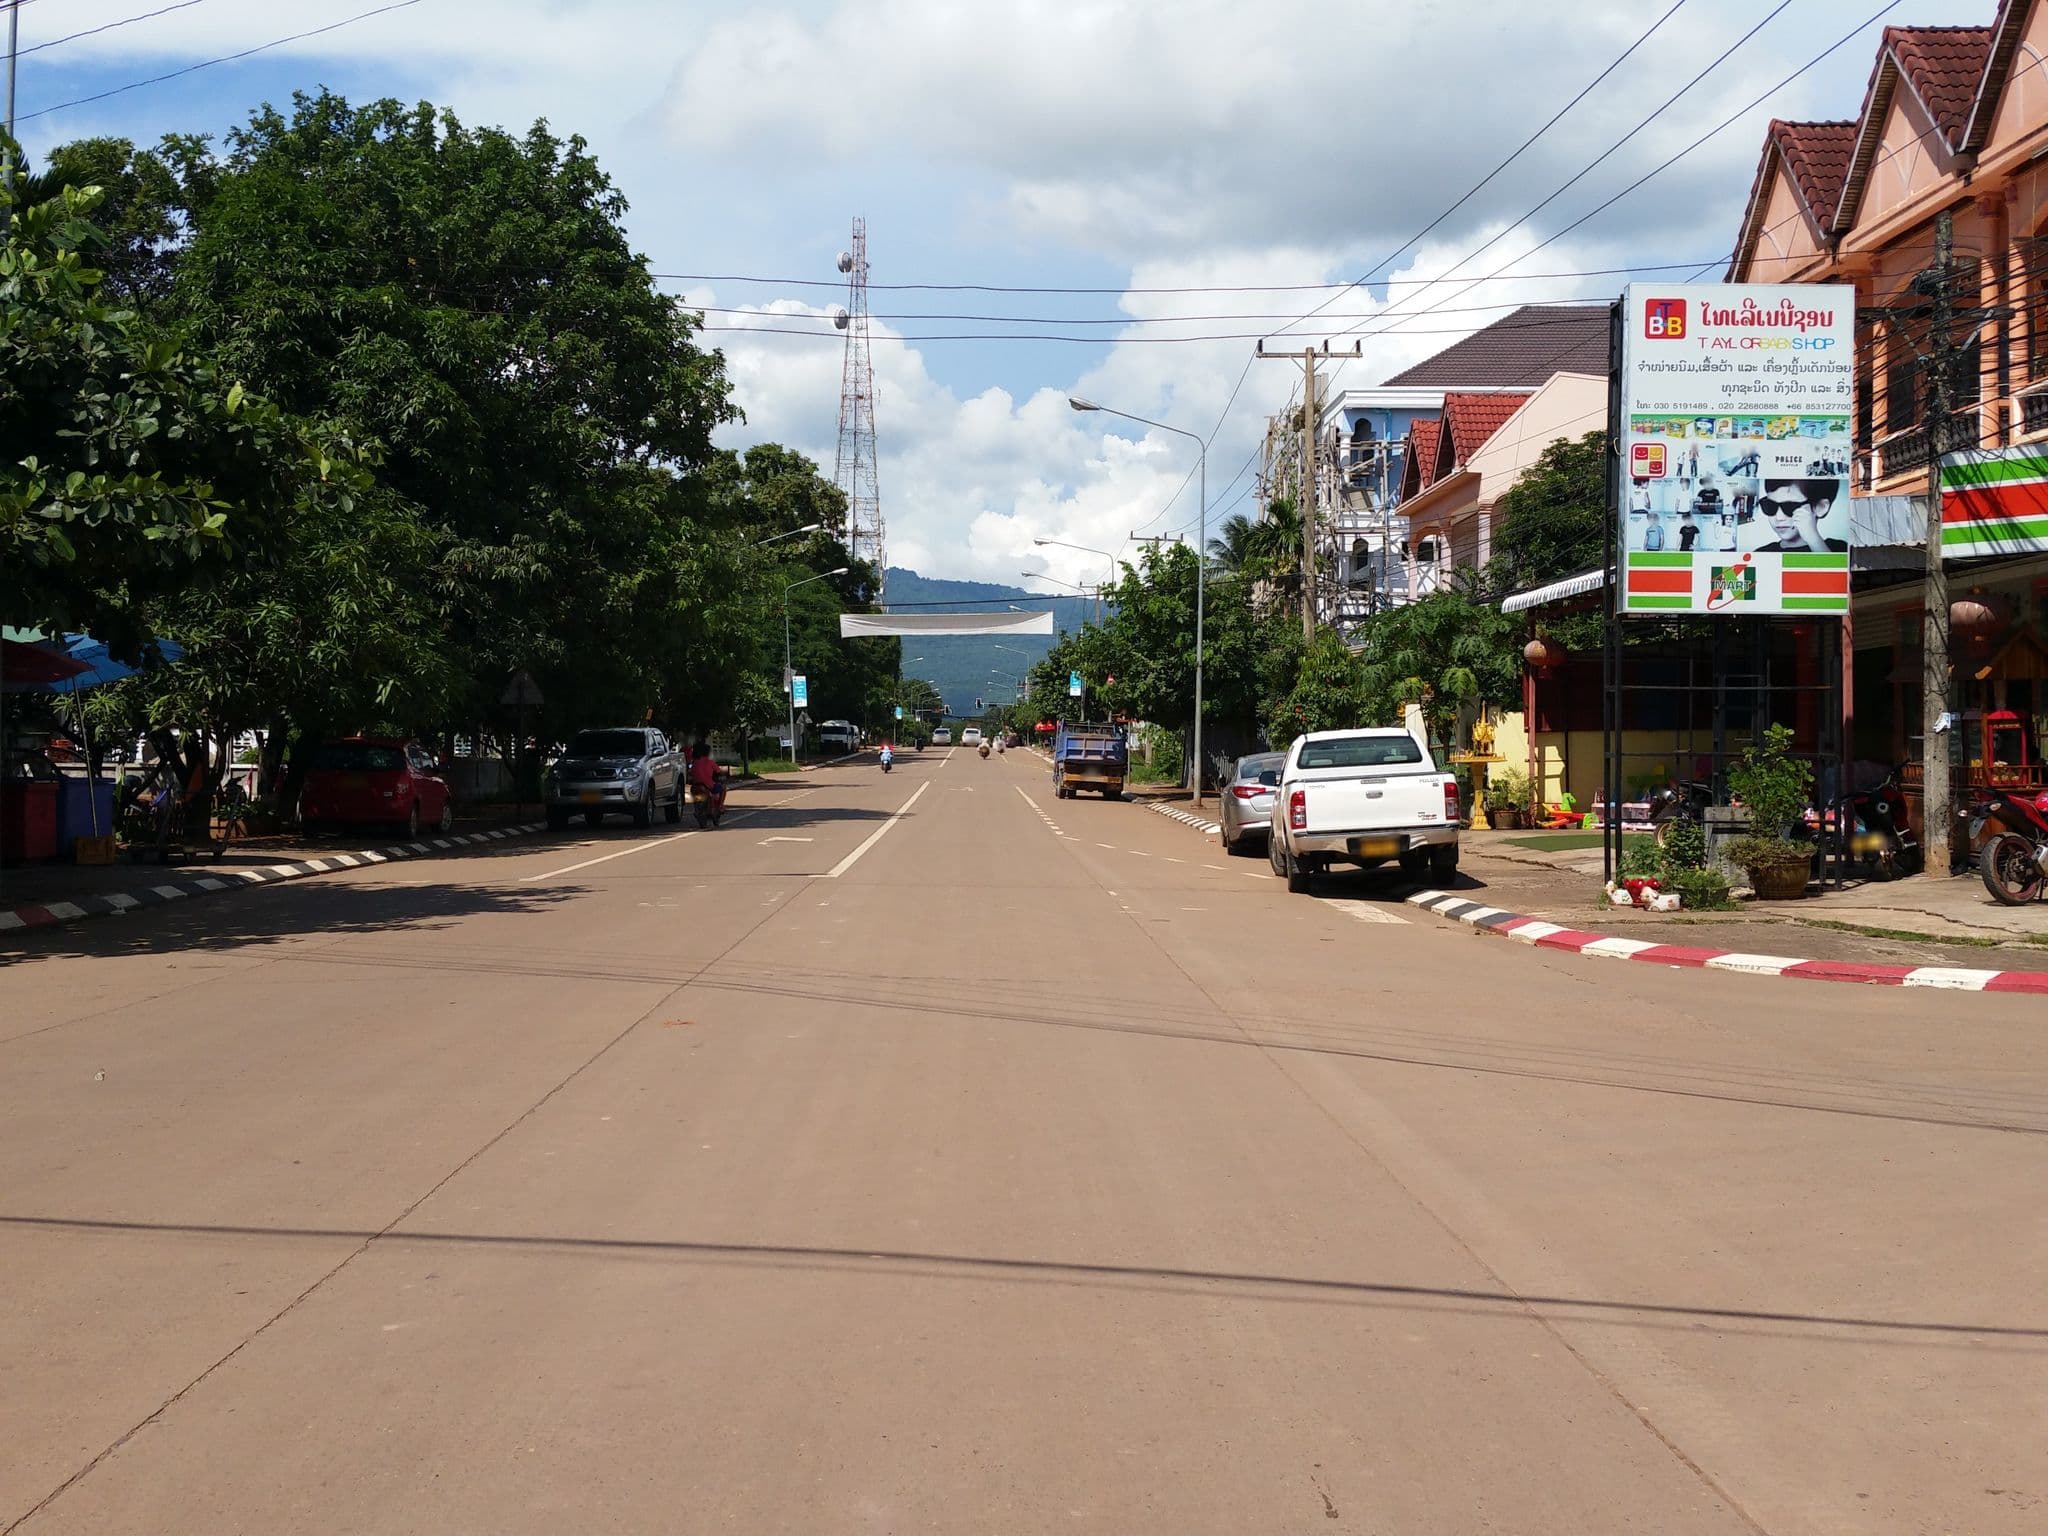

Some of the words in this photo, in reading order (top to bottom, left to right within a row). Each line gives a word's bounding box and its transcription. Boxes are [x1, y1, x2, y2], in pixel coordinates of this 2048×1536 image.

[1792, 337, 1835, 350] SHOP
[1738, 363, 1758, 373] ແລະ
[1811, 384, 1832, 393] ແລະ
[1653, 402, 1670, 410] 030
[1718, 402, 1735, 410] 020
[1714, 579, 1752, 592] MART
